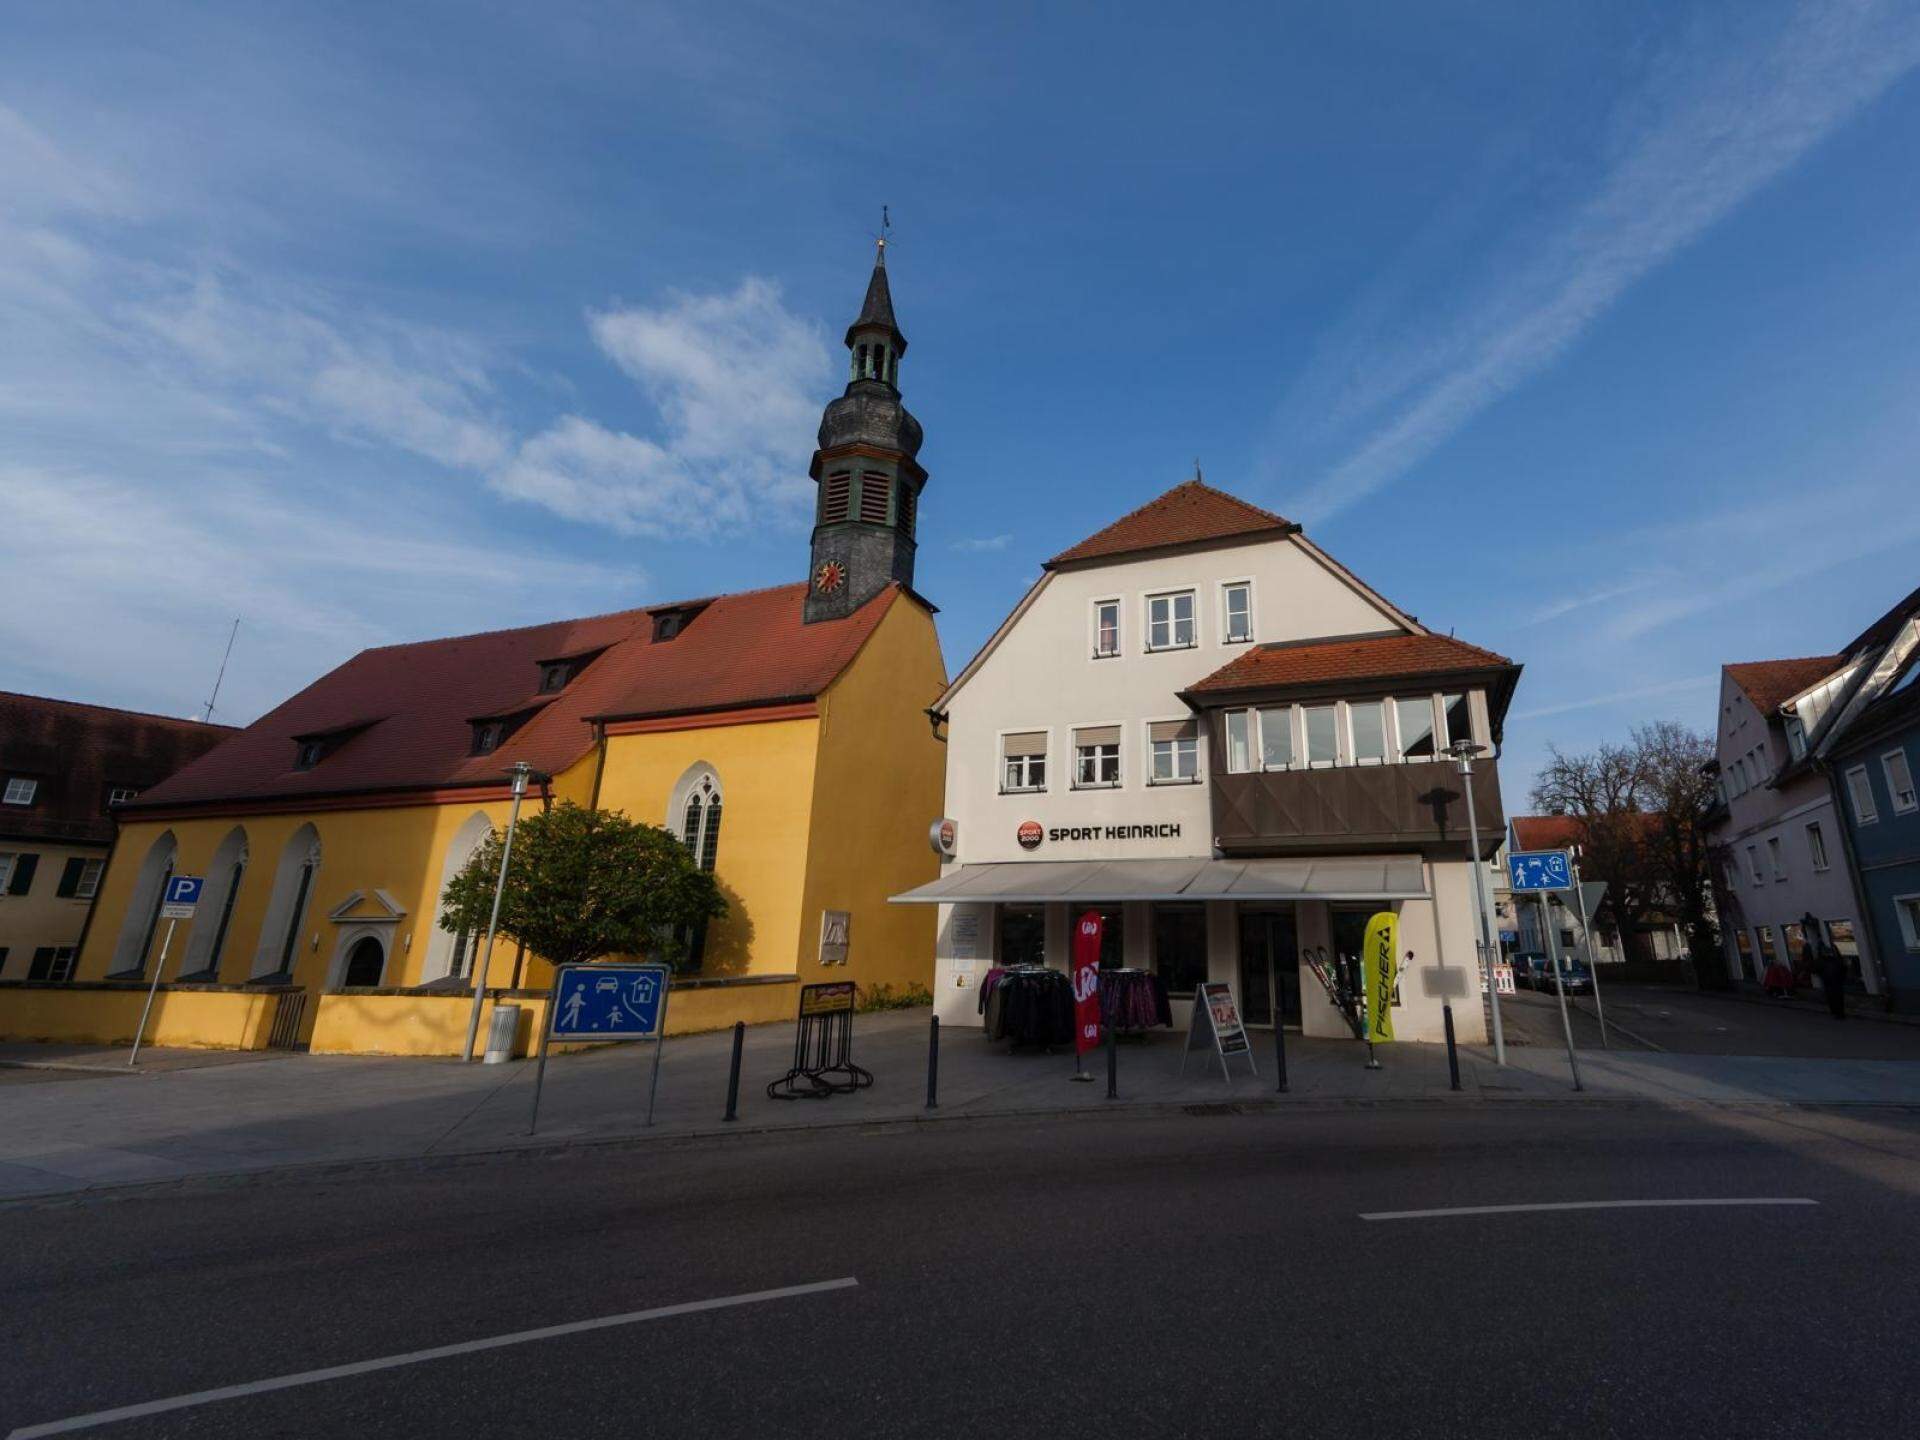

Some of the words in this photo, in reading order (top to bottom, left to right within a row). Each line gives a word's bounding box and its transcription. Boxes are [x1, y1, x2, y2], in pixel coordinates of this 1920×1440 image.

[1018, 828, 1042, 836] SPORT
[1021, 834, 1040, 842] 2000
[1050, 826, 1102, 841] SPORT
[1106, 824, 1181, 840] HEINRICH
[173, 880, 196, 900] P
[1376, 942, 1390, 1038] FISCHER
